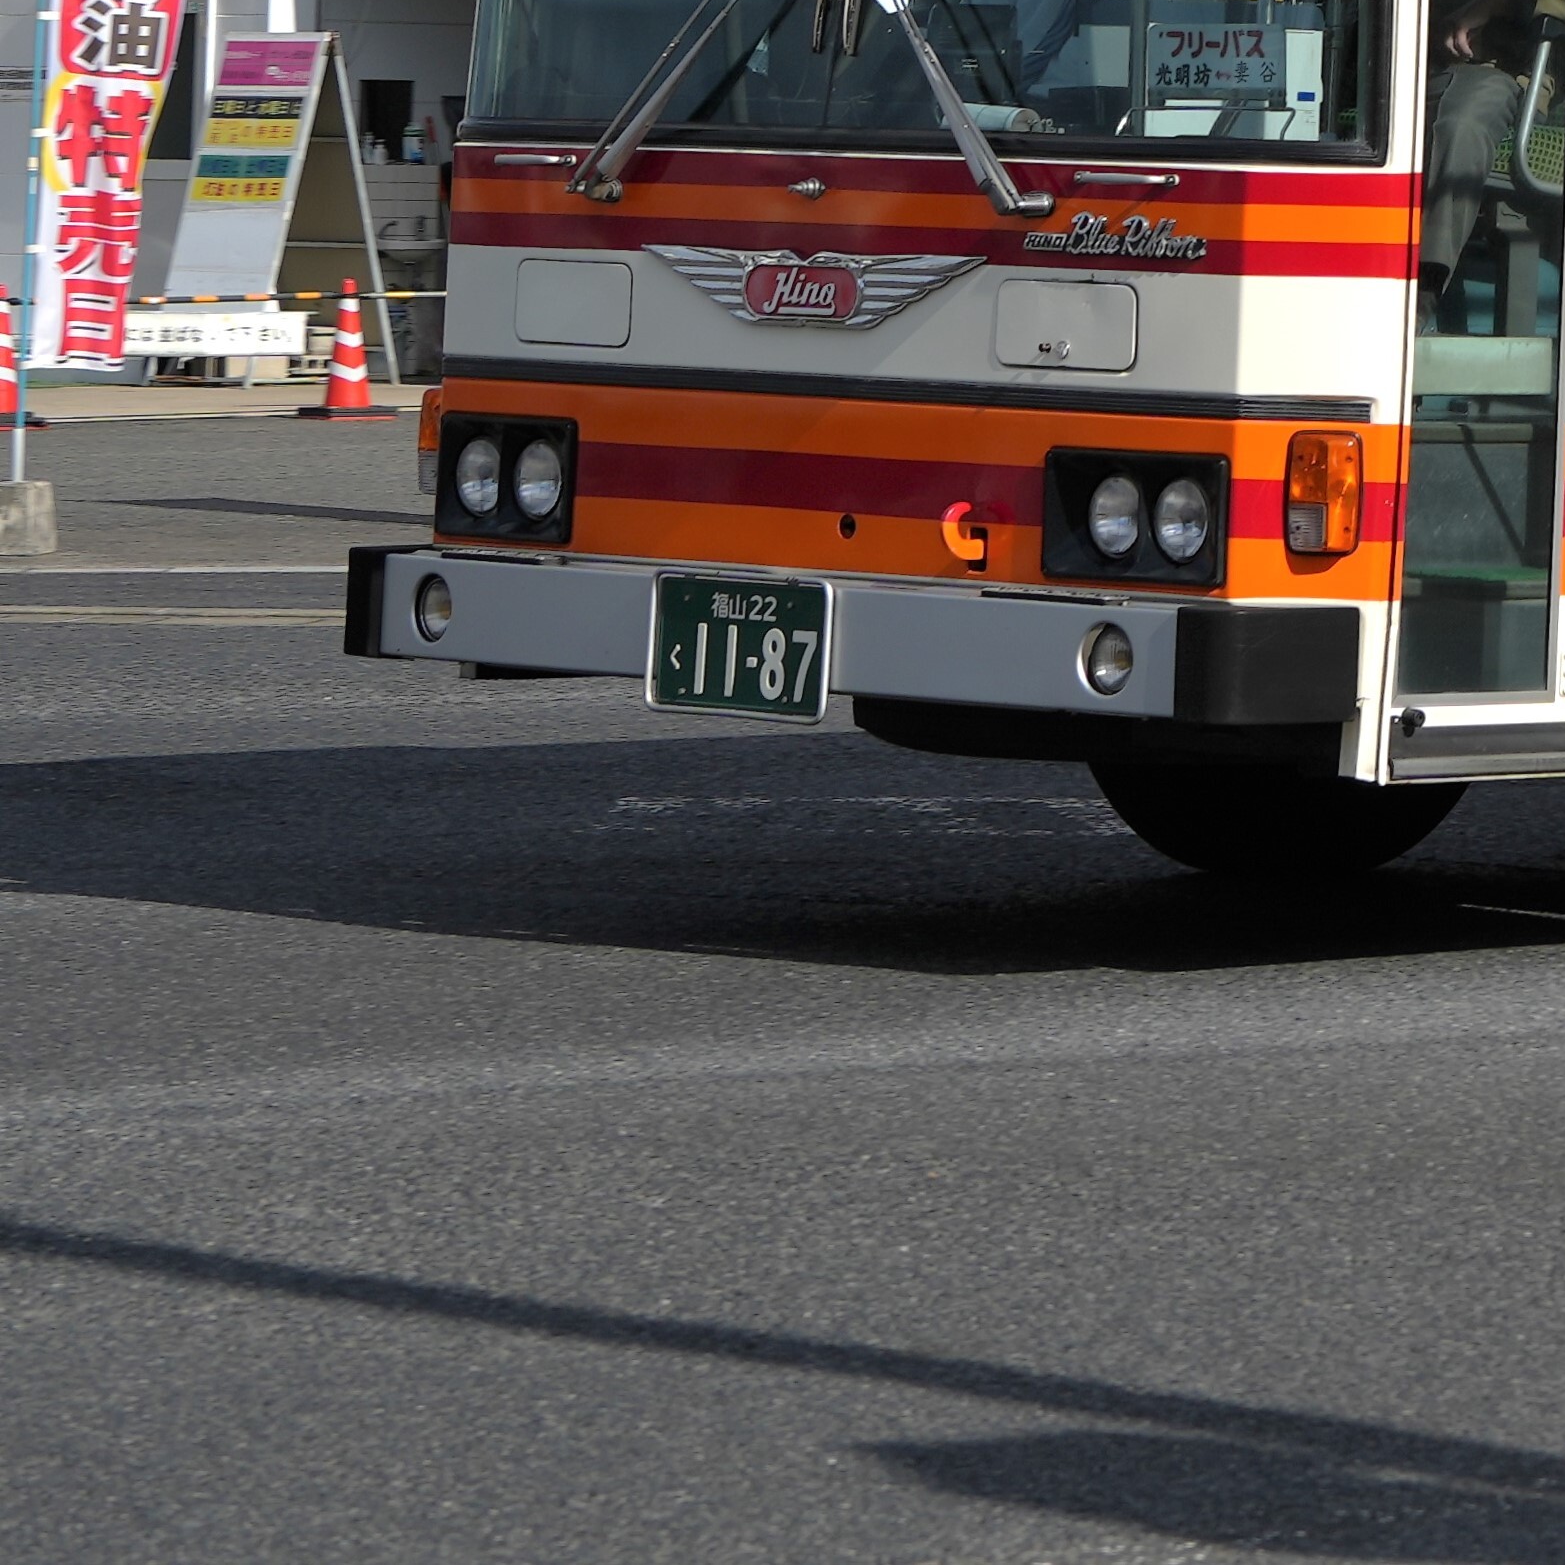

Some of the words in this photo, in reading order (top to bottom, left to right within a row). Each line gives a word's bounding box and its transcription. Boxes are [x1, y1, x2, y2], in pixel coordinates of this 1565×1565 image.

[1166, 29, 1265, 58] フリーバス
[1156, 63, 1212, 87] 光明坊
[1234, 60, 1277, 83] 妻谷
[1066, 211, 1120, 255] Blue
[1121, 215, 1206, 260] Ribbon
[763, 267, 836, 314] Hino
[669, 643, 682, 670] く
[693, 622, 818, 704] 11-87
